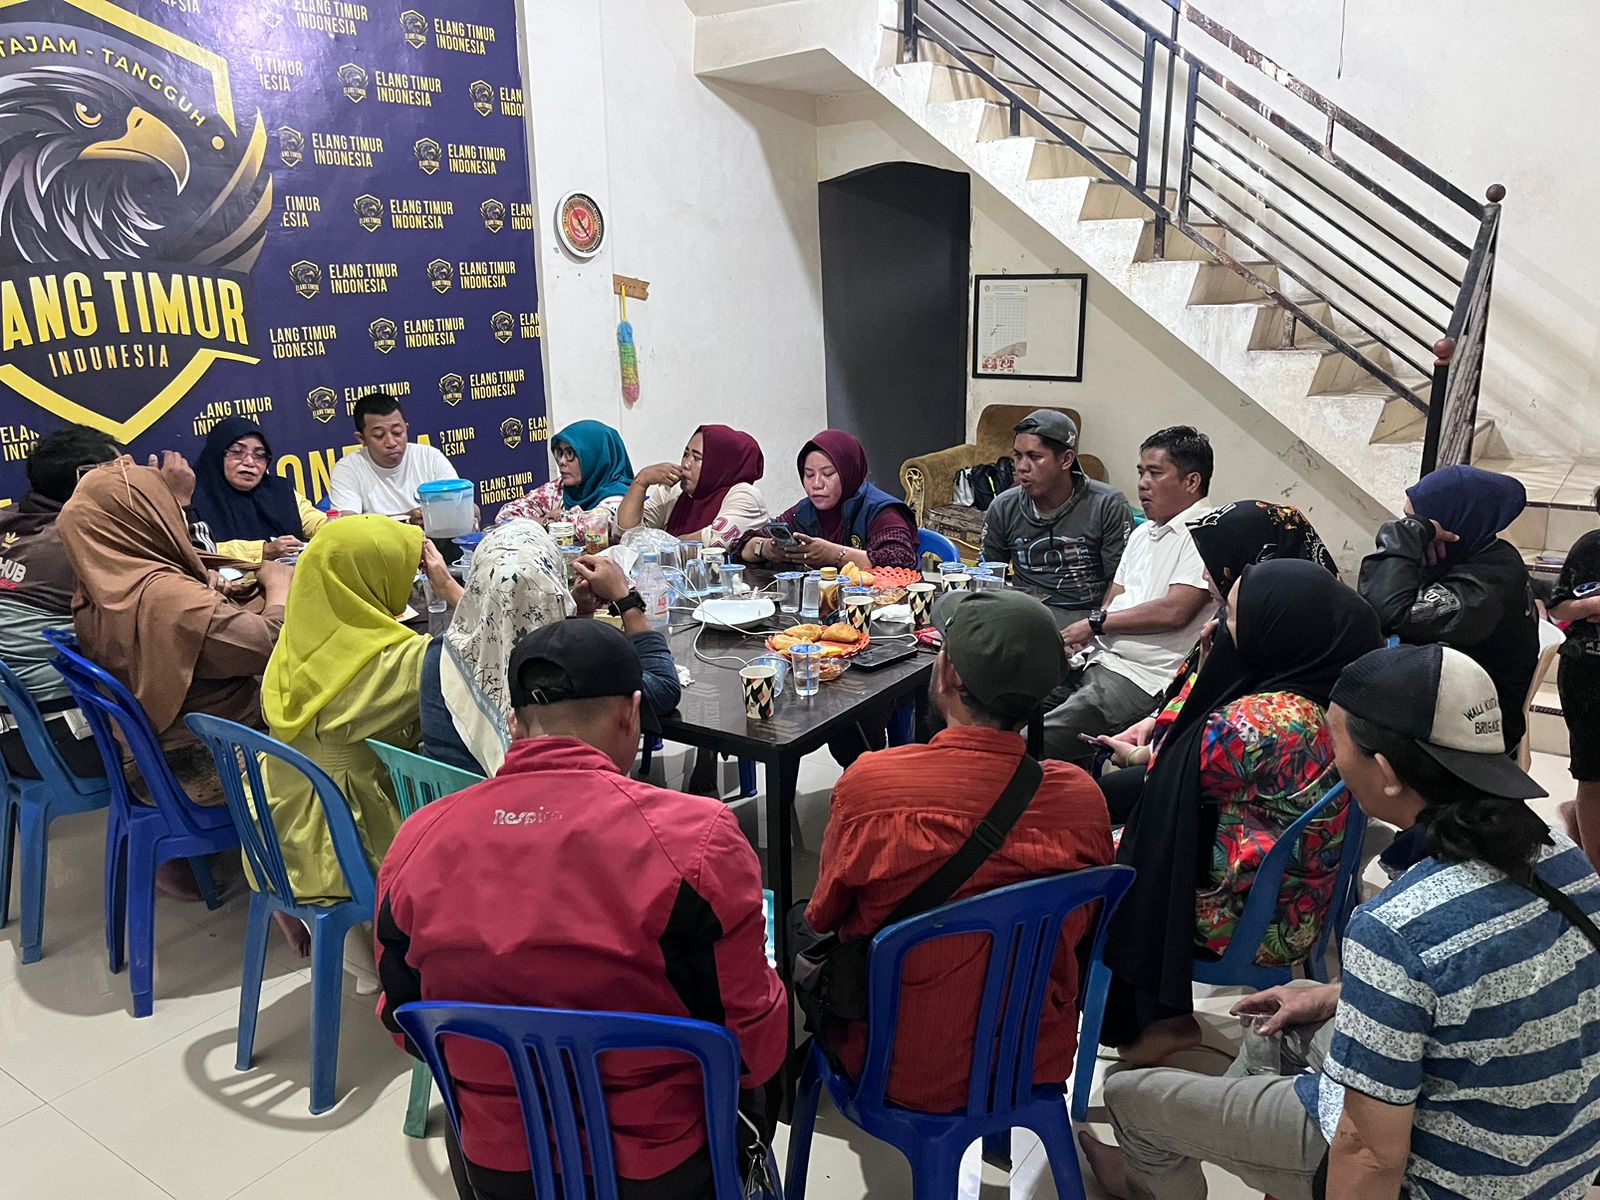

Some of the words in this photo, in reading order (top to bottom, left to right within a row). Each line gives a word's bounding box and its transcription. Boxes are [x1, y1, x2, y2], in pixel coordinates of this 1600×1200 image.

[333, 1, 368, 21] TIMUR
[297, 12, 357, 35] INDONESIA
[434, 18, 465, 37] ELANG
[466, 23, 495, 42] TIMUR
[435, 34, 486, 55] INDONESIA
[265, 58, 303, 77] TIMUR
[102, 48, 206, 127] TANGGUH
[375, 70, 408, 89] ELANG
[410, 75, 442, 93] TIMUR
[377, 86, 432, 107] INDONESIA
[312, 133, 347, 150] ELANG
[349, 136, 383, 152] TIMUR
[314, 149, 373, 168] INDONESIA
[448, 144, 476, 159] ELANG
[478, 146, 506, 161] TIMUR
[449, 158, 497, 175] INDONESIA
[285, 195, 320, 212] TIMUR
[390, 199, 421, 214] ELANG
[423, 200, 453, 215] TIMUR
[391, 214, 444, 229] INDONESIA
[329, 264, 363, 279] ELANG
[365, 263, 398, 278] TIMUR
[459, 262, 487, 275] ELANG
[489, 261, 516, 274] TIMUR
[330, 279, 388, 294] INDONESIA
[460, 275, 507, 289] INDONESIA
[103, 271, 249, 345] TIMUR
[301, 325, 337, 341] TIMUR
[404, 319, 434, 334] ELANG
[436, 317, 465, 332] TIMUR
[405, 331, 456, 348] INDONESIA
[48, 344, 169, 378] INDONESIA
[470, 373, 498, 387] ELANG
[499, 369, 525, 383] TIMUR
[379, 382, 411, 397] TIMUR
[471, 383, 516, 400] INDONESIA
[234, 396, 273, 414] TIMUR
[447, 427, 475, 442] TIMUR
[480, 476, 506, 493] ELANG
[507, 471, 533, 486] TIMUR
[481, 486, 525, 505] INDONESIA
